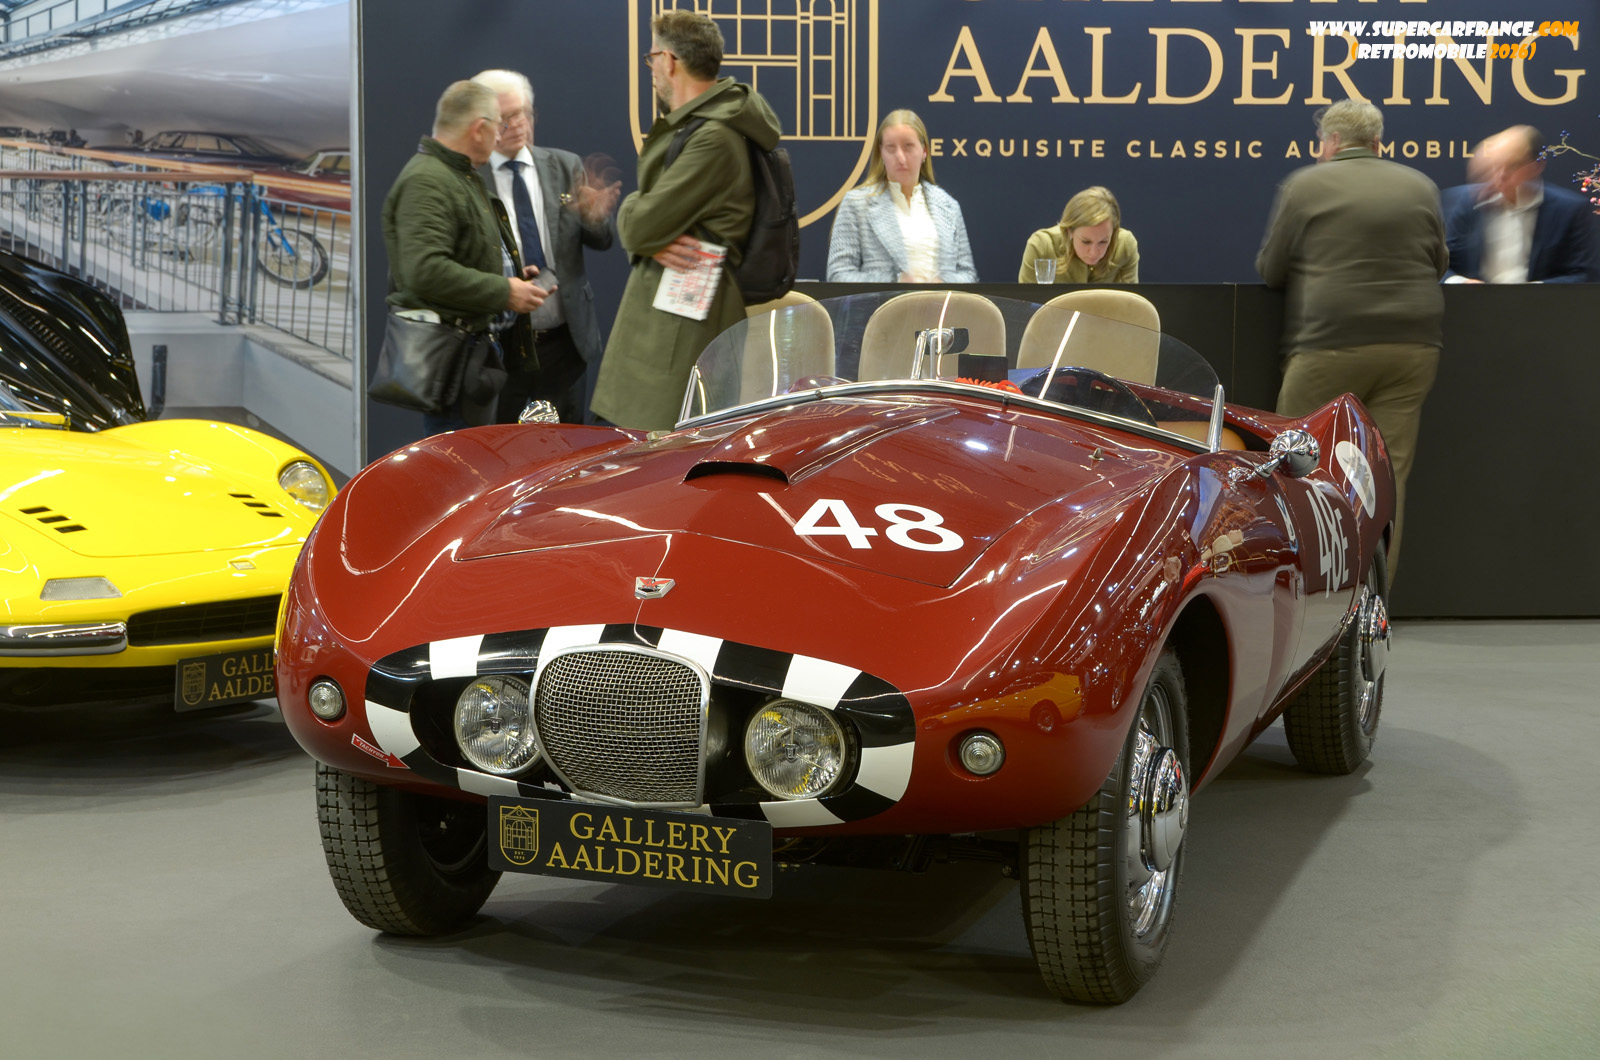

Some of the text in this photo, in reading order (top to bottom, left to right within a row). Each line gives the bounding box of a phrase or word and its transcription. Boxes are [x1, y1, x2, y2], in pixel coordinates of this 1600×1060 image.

[928, 25, 1587, 106] AALDERING
[930, 138, 1476, 158] EXQUISITE CLASSIC AUMOBIL
[793, 498, 965, 552] 48
[222, 653, 274, 677] GALL
[208, 674, 274, 701] AALDE
[569, 812, 737, 854] GALLERY
[546, 842, 760, 888] AALDERING
